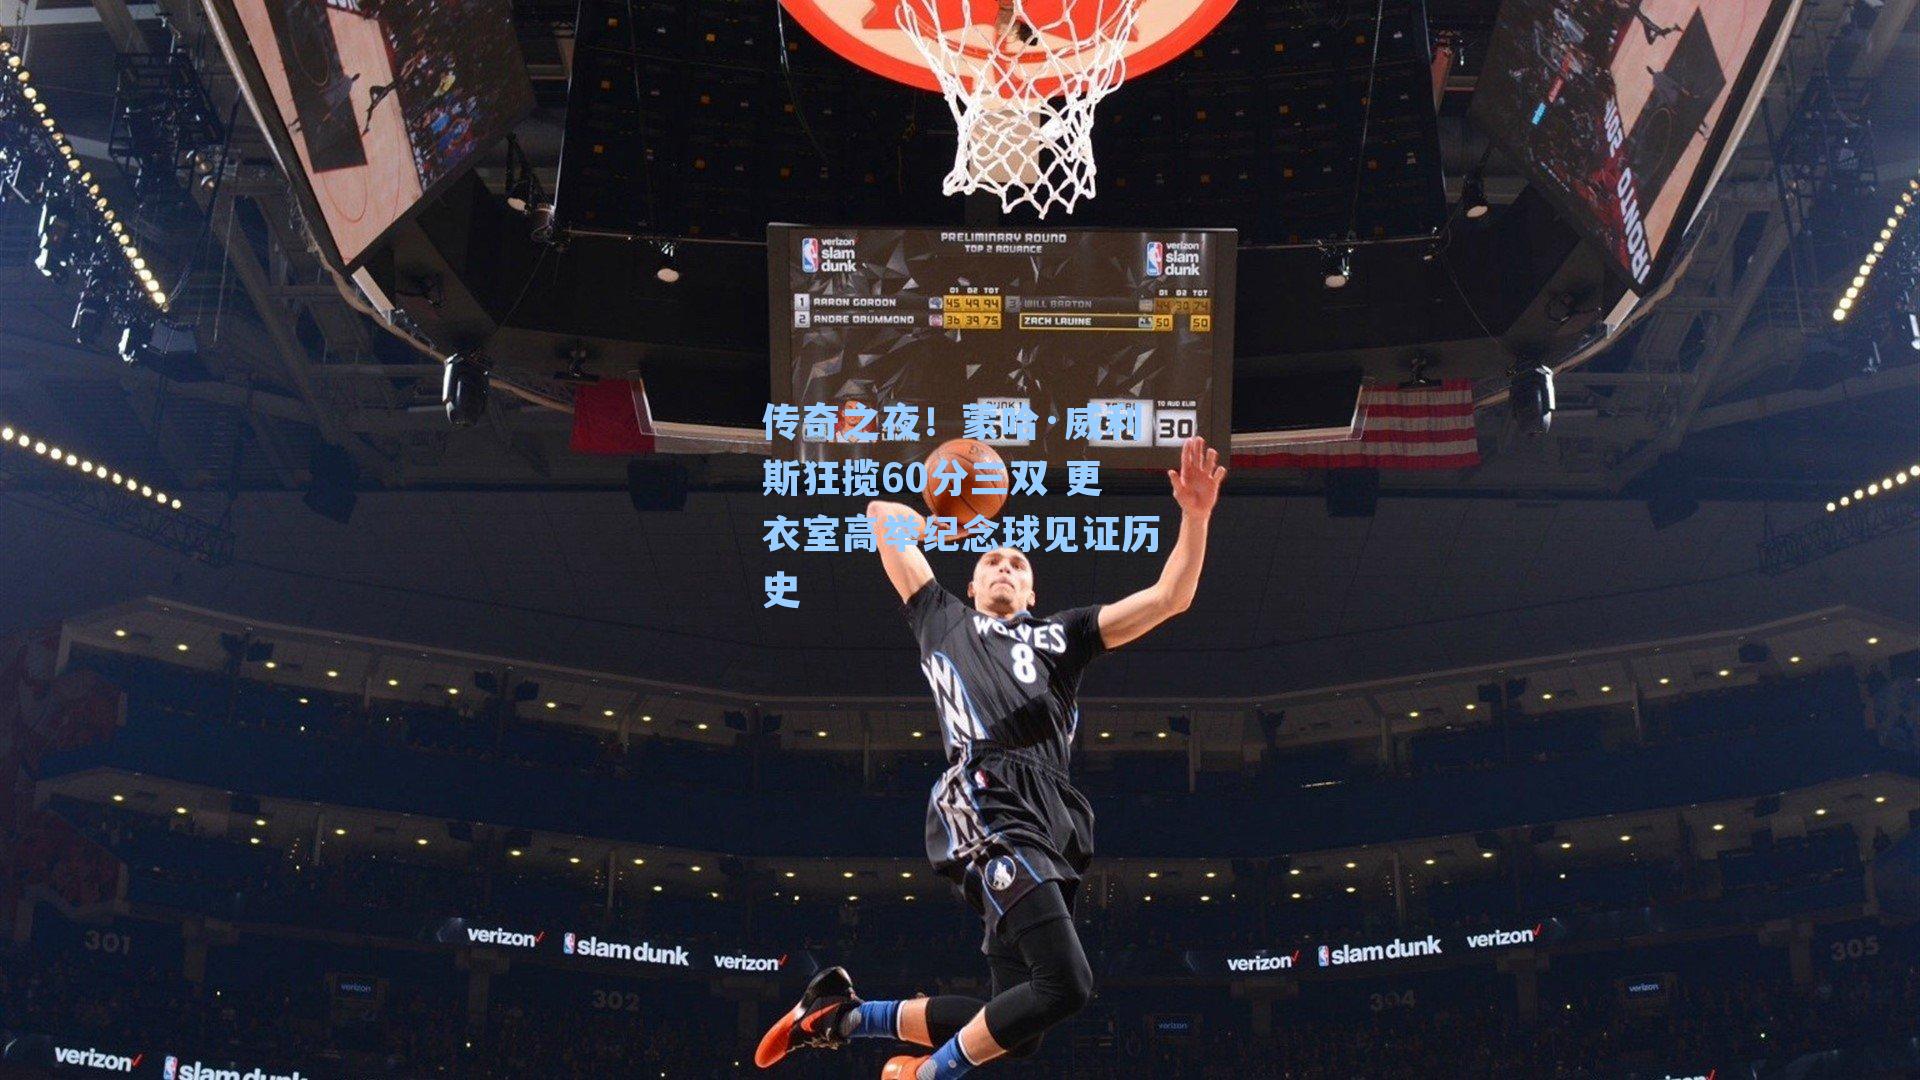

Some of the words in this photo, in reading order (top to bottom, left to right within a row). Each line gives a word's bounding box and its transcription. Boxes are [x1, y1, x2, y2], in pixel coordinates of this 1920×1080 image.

[1617, 167, 1650, 284] RONTO
[821, 237, 856, 247] verizon
[940, 232, 1022, 243] PRELIMINARY
[1025, 233, 1067, 244] ROUND
[965, 244, 984, 253] TOP
[986, 245, 993, 253] 2
[1165, 241, 1200, 251] verizon
[821, 247, 856, 260] slam
[1165, 252, 1200, 264] slam
[821, 259, 857, 273] dunk
[1164, 263, 1200, 276] dunk
[983, 286, 999, 294] TOT
[813, 297, 850, 307] AARON
[853, 298, 896, 307] GORDON
[946, 298, 960, 308] 45
[965, 298, 980, 308] 49
[983, 298, 999, 308] 94
[1024, 299, 1048, 308] WILL
[1050, 299, 1092, 309] BARTON
[799, 314, 806, 324] 2
[813, 314, 850, 324] ANDRE
[853, 315, 914, 324] DRUMMOND
[946, 316, 960, 325] 36
[965, 316, 980, 325] 39
[983, 316, 999, 326] 75
[1024, 316, 1052, 326] ZACH
[1156, 317, 1170, 327] 50
[1193, 317, 1208, 327] 50
[1160, 418, 1192, 438] 30
[1011, 643, 1037, 684] 8
[468, 927, 535, 948] verizon
[1467, 929, 1534, 948] verizon
[577, 936, 631, 960] slam
[633, 942, 689, 966] dunk
[1331, 944, 1384, 965] slam
[1386, 934, 1442, 959] dunk
[1830, 935, 1879, 961] 305
[714, 953, 779, 971] verizon
[1227, 953, 1292, 971] verizon
[54, 1045, 133, 1072] verizon
